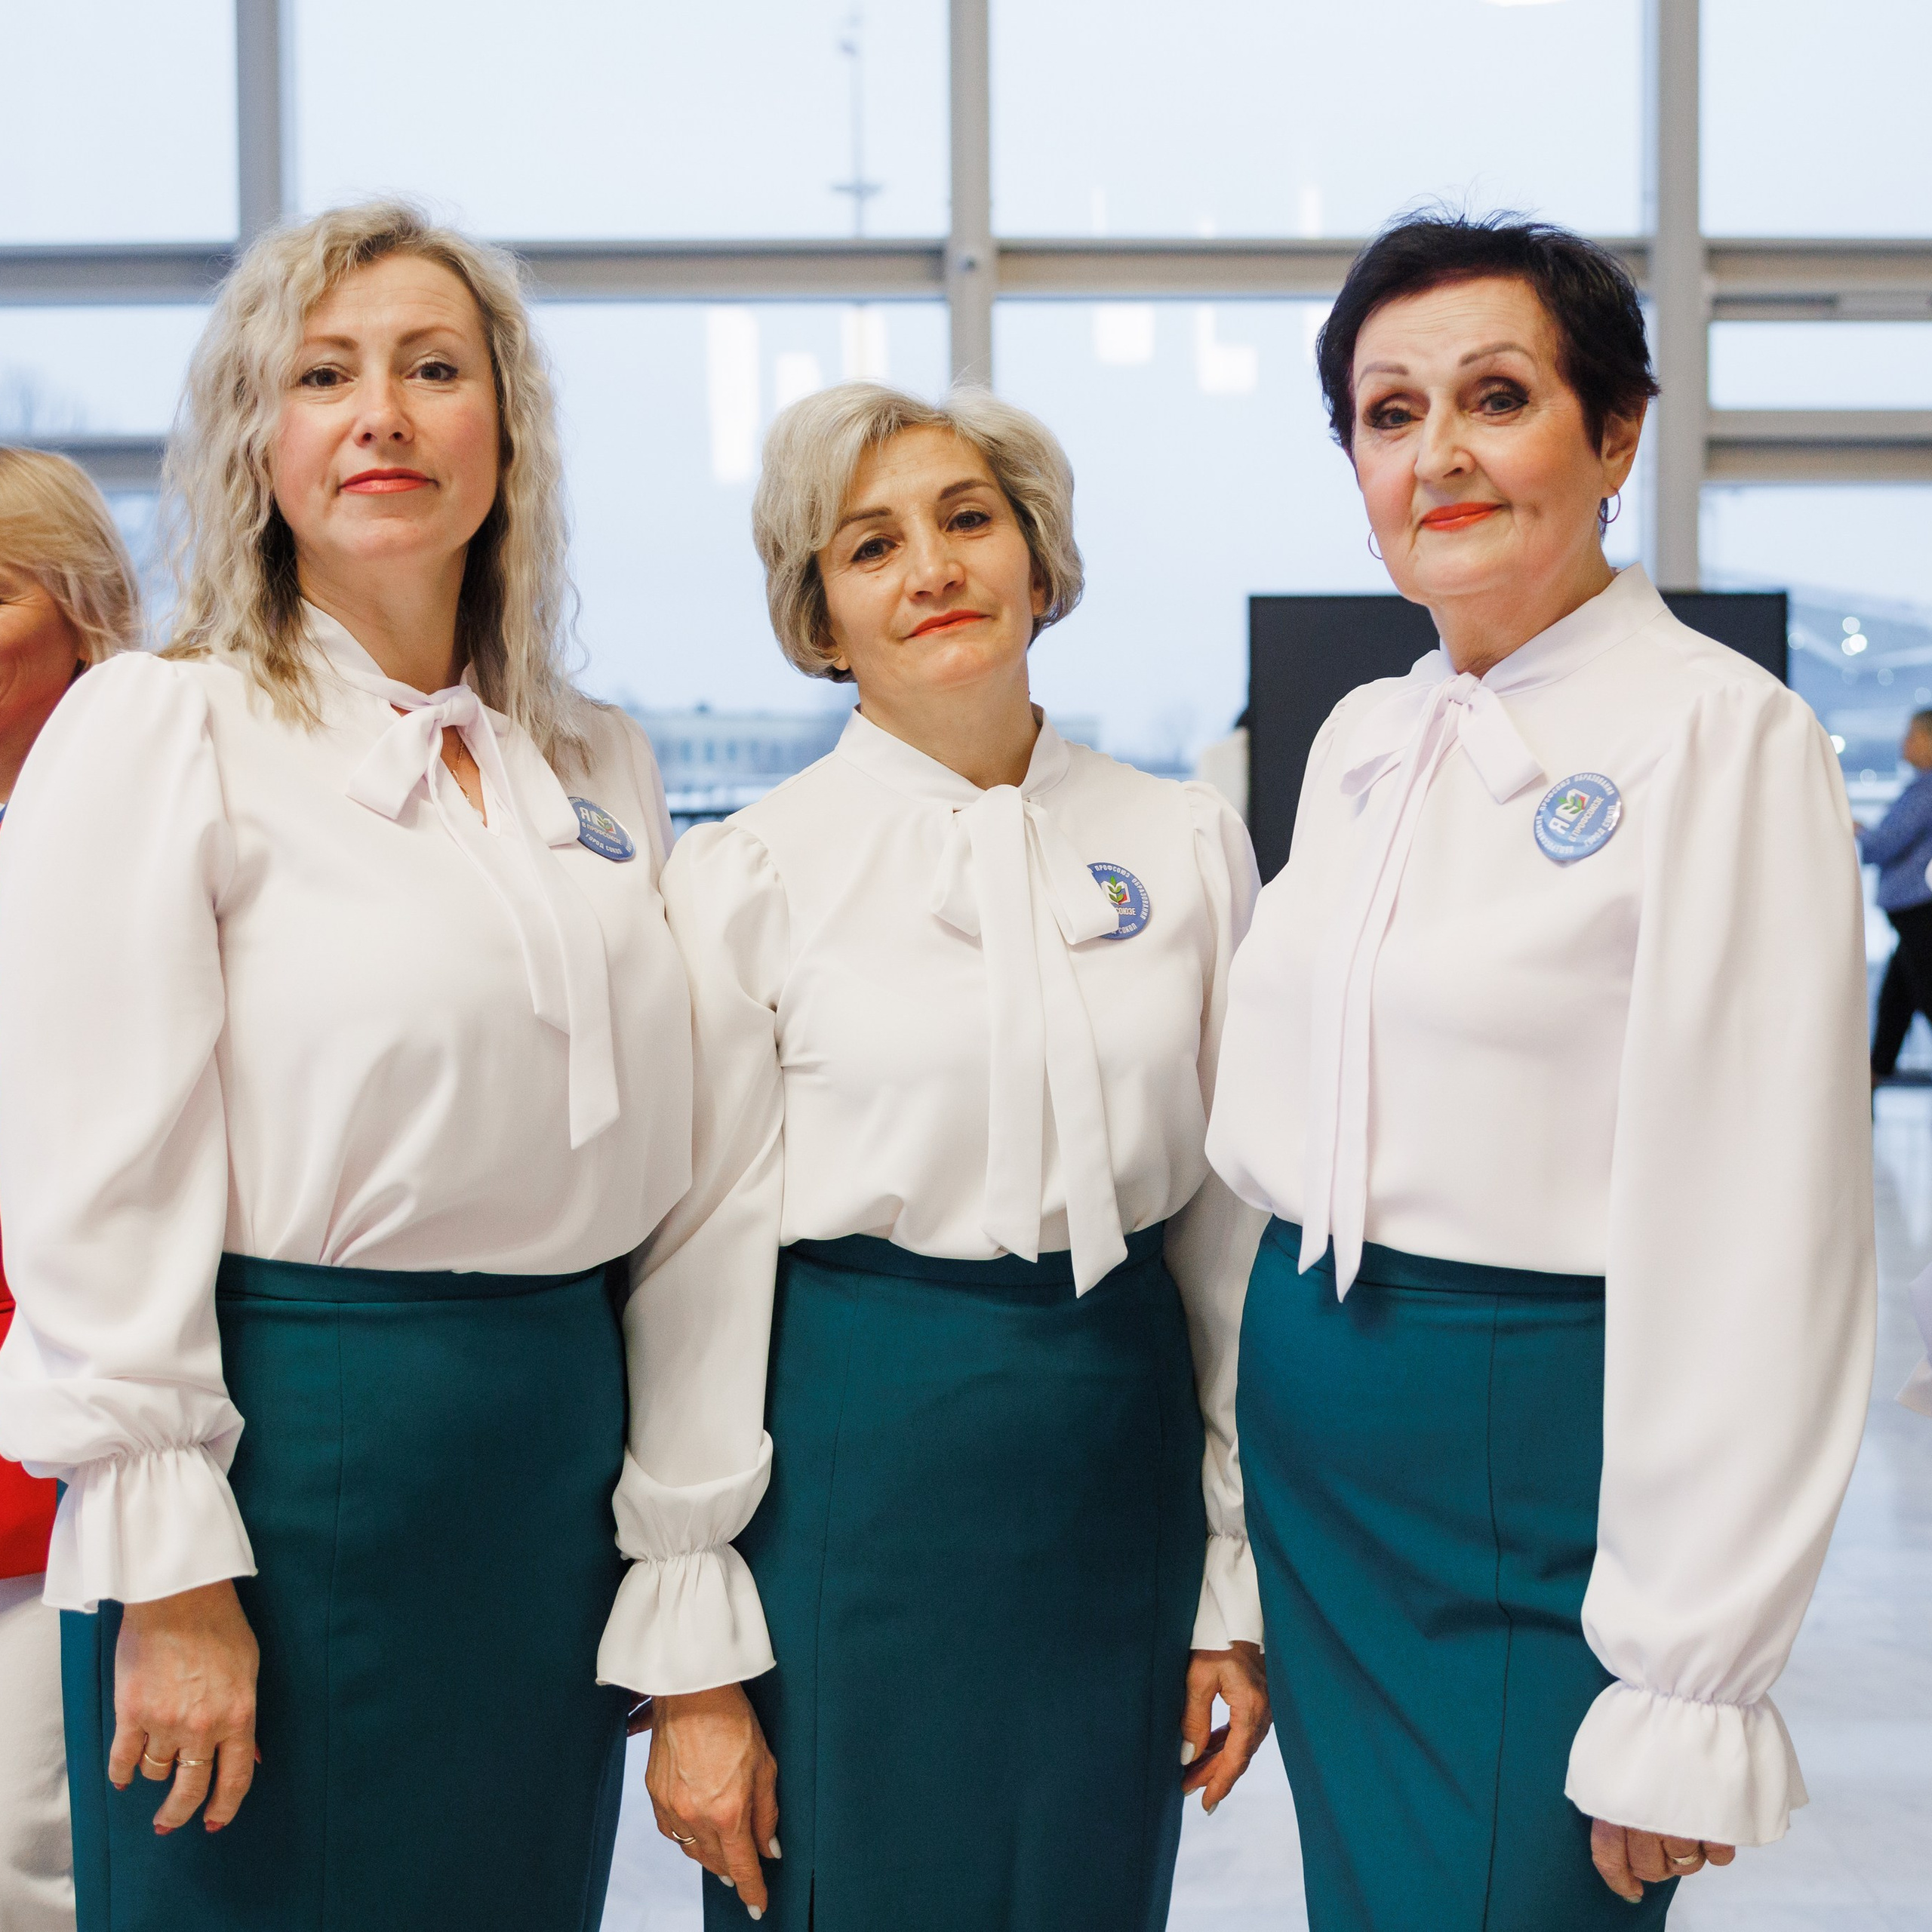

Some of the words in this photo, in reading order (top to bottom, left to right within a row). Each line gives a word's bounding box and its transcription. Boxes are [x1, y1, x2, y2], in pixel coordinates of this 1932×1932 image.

[579, 807, 591, 822] Я
[1571, 795, 1604, 837] ПРОФСОЮЗЕ
[1548, 817, 1571, 835] Я
[586, 833, 604, 849] ГОРОД
[1094, 864, 1131, 878] ПРОФСОЮЗ
[1131, 878, 1149, 920] ОБРАЗОВАНИЯ
[1116, 907, 1137, 915] СОЮЗЕ
[1118, 922, 1137, 934] СОКОЛ
